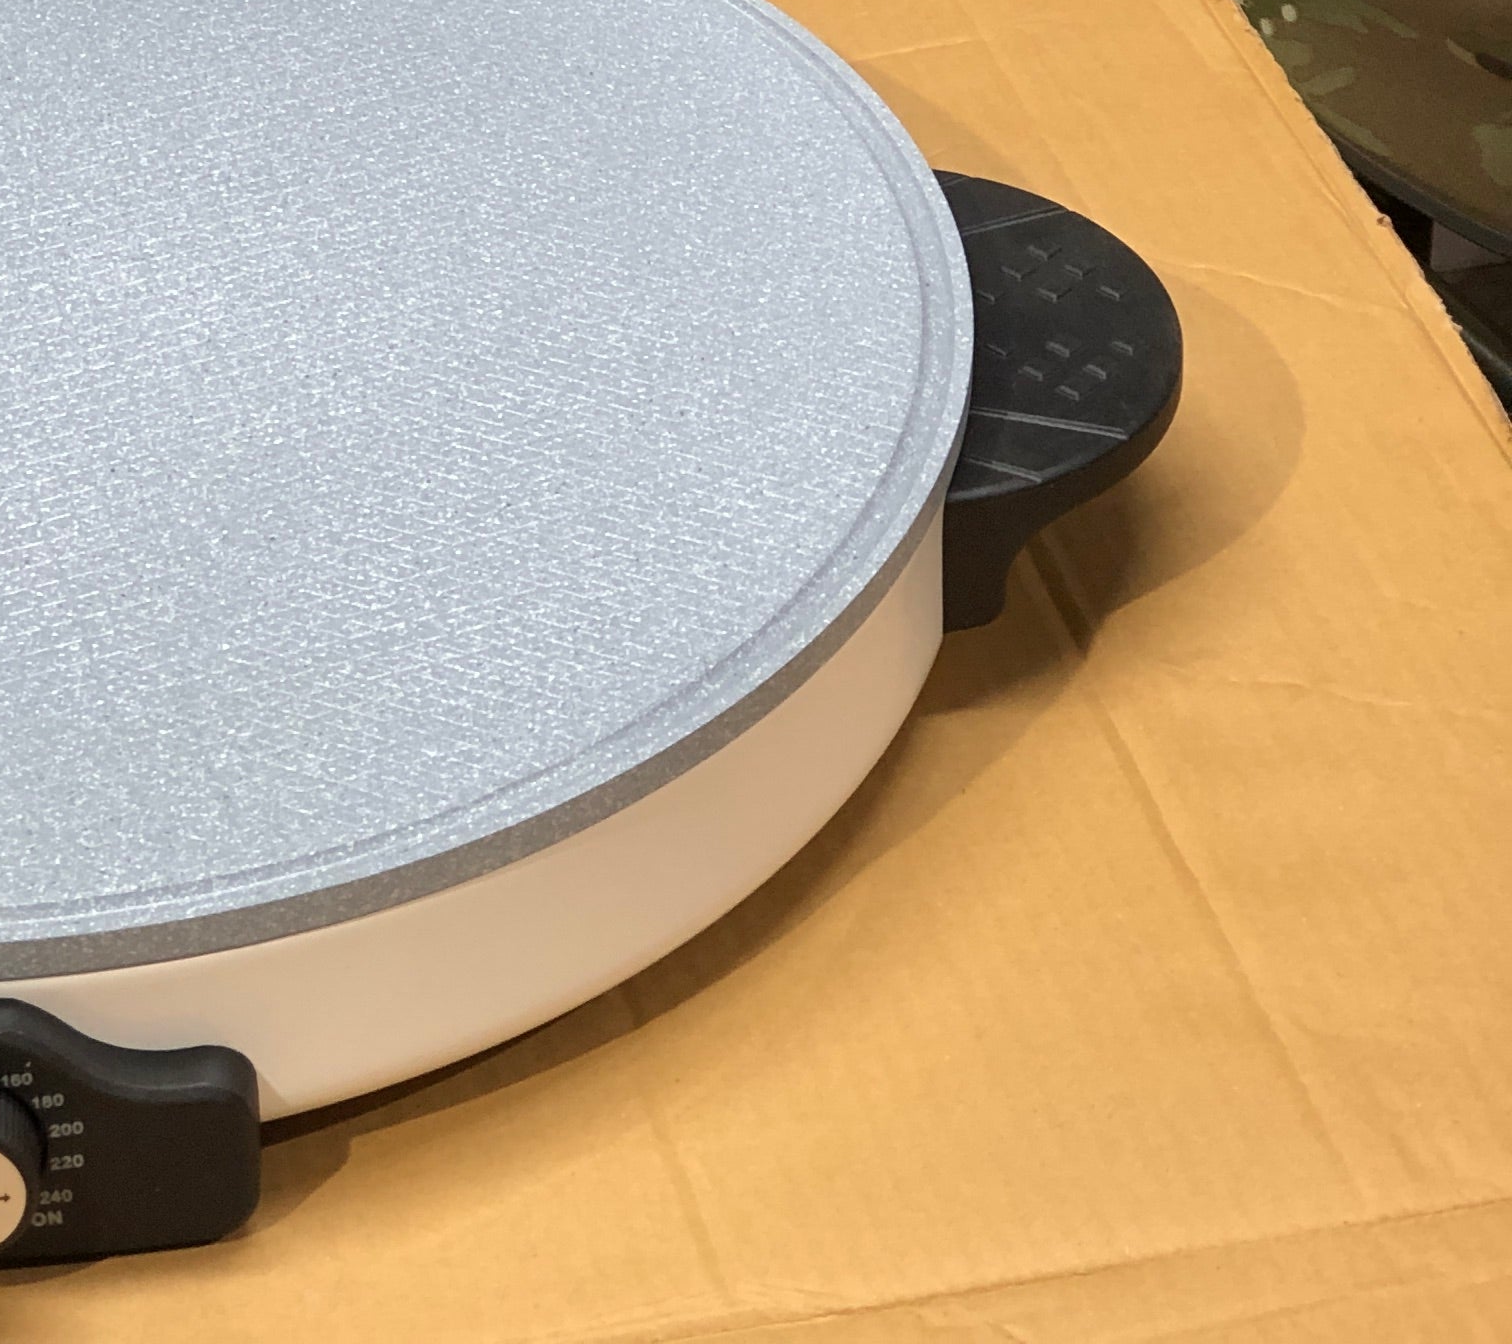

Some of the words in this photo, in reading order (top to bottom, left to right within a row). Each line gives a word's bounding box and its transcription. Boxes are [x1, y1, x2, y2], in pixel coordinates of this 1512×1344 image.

[48, 1120, 85, 1139] 200
[50, 1153, 85, 1171] 220
[40, 1189, 74, 1205] 240
[31, 1210, 64, 1227] ON
